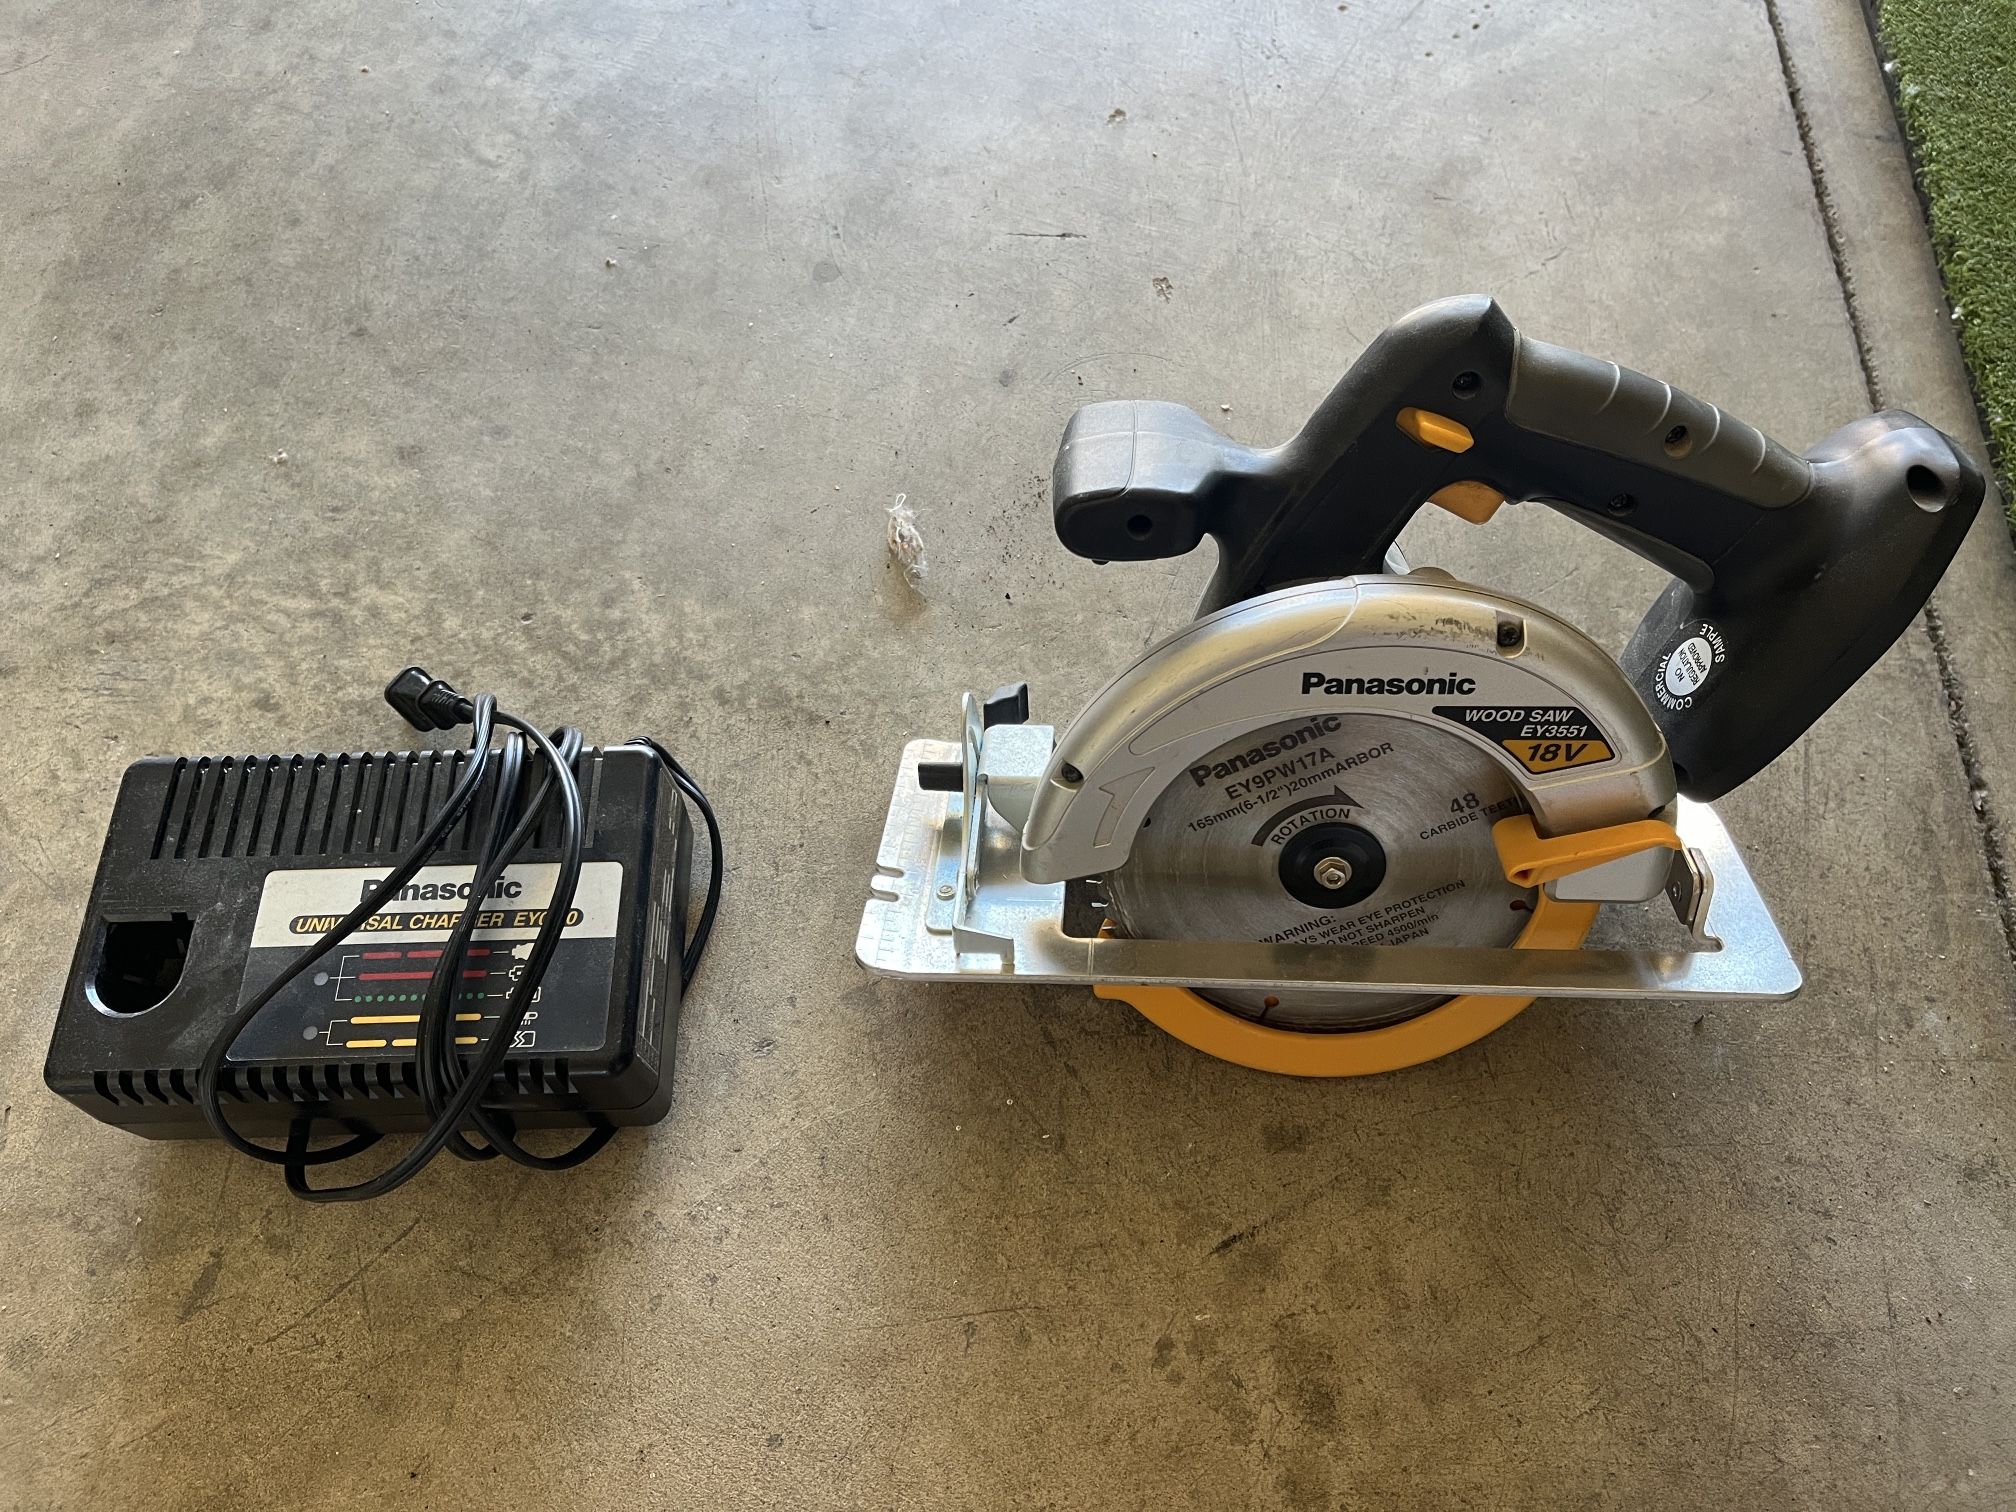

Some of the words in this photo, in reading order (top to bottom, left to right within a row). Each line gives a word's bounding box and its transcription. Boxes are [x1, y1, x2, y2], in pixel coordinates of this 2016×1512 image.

[1700, 623, 1726, 663] SAMPLE
[1675, 667, 1686, 683] NO
[1678, 648, 1701, 686] REGULATION
[1301, 672, 1476, 695] Panasonic
[1655, 652, 1693, 711] COMMERCIAL
[1465, 709, 1526, 722] WOOD
[1529, 709, 1574, 722] SAW
[1520, 725, 1588, 738] EY3551
[1188, 715, 1342, 787] Panasonic
[1527, 743, 1589, 763] 18V
[1224, 747, 1336, 800] EY9PW17A
[1450, 792, 1480, 813] 48
[1270, 807, 1351, 845] ROTATION
[1420, 812, 1479, 840] CARBIDE
[1320, 920, 1356, 939] WEAR
[1358, 910, 1384, 925] EYE
[1384, 879, 1466, 915] PROTECTION
[296, 916, 403, 933] UNIVSAL
[1339, 928, 1364, 945] NOT
[1367, 906, 1426, 933] SHARPEN
[1387, 913, 1439, 938] 4500/min
